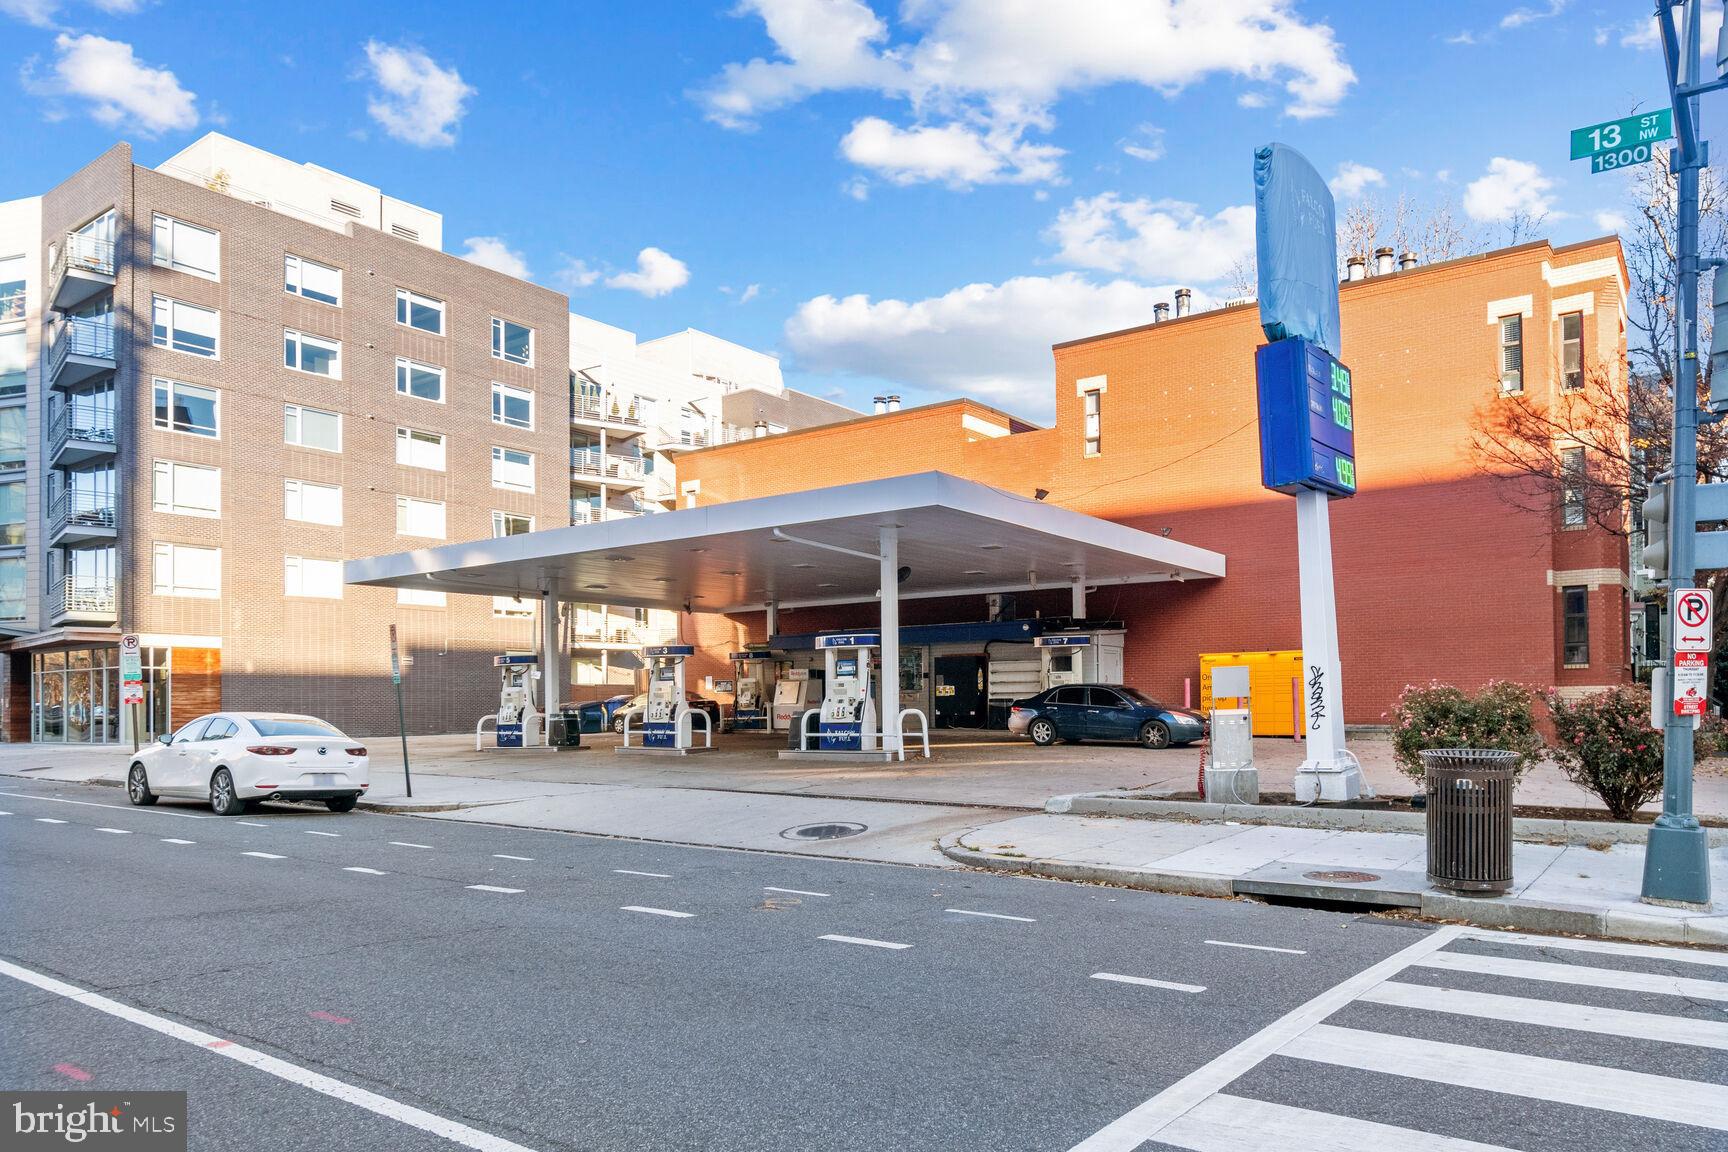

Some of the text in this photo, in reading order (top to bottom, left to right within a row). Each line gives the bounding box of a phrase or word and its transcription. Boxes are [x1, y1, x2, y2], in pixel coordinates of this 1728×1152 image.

[1640, 114, 1659, 128] ST
[1588, 124, 1622, 151] 13
[1639, 127, 1659, 141] NW
[1595, 145, 1648, 171] 1300
